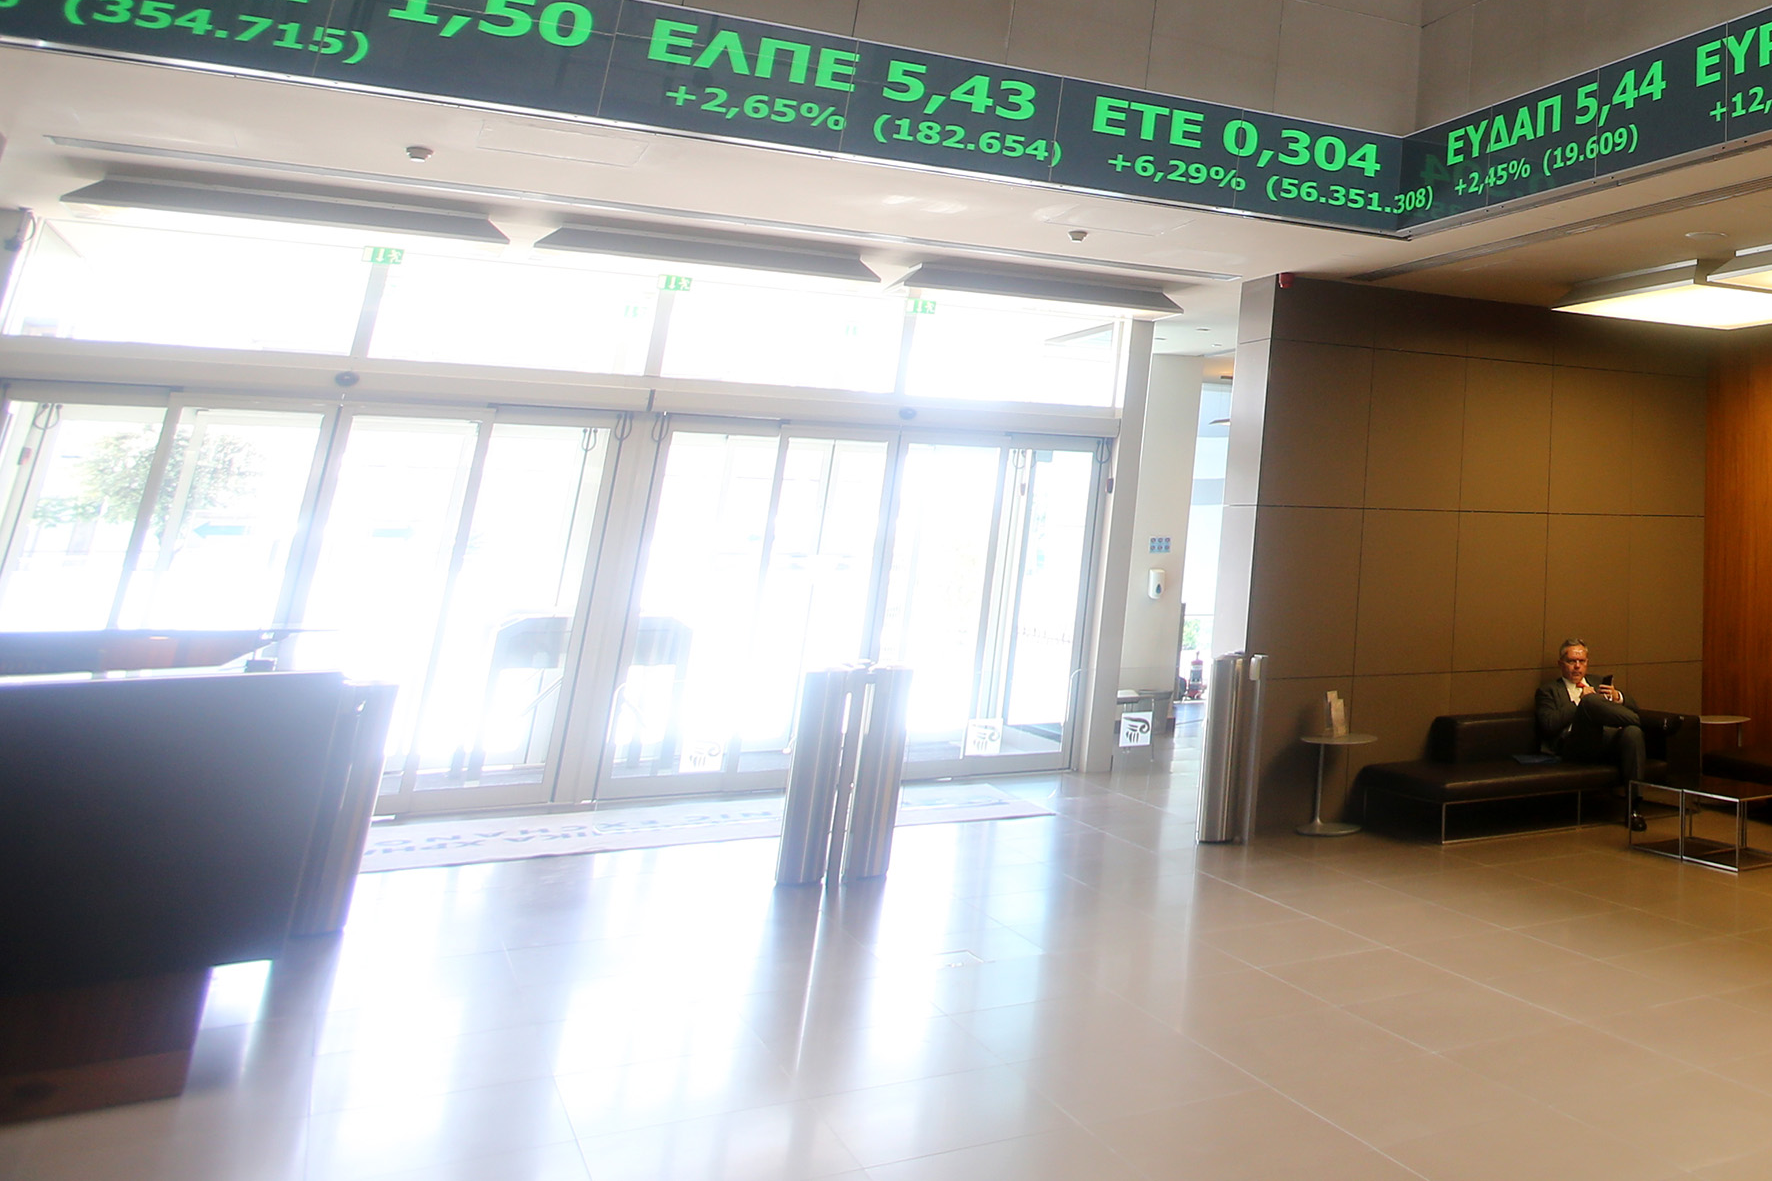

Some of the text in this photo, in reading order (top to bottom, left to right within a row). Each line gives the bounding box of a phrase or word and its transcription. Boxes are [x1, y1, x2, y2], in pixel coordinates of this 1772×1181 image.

[647, 18, 1037, 123] ΕΛΠΕ 5,43
[665, 84, 1062, 168] +2,65% (182.654)
[1092, 96, 1202, 149] ΕΤΕ
[1222, 119, 1382, 177] 0,304
[1446, 60, 1667, 166] ΕΥΔΑΠ 5,44
[1108, 152, 1434, 216] +6,29% (56.351.308)
[1454, 157, 1531, 195] +2,45%
[1542, 124, 1639, 177] (19.609)
